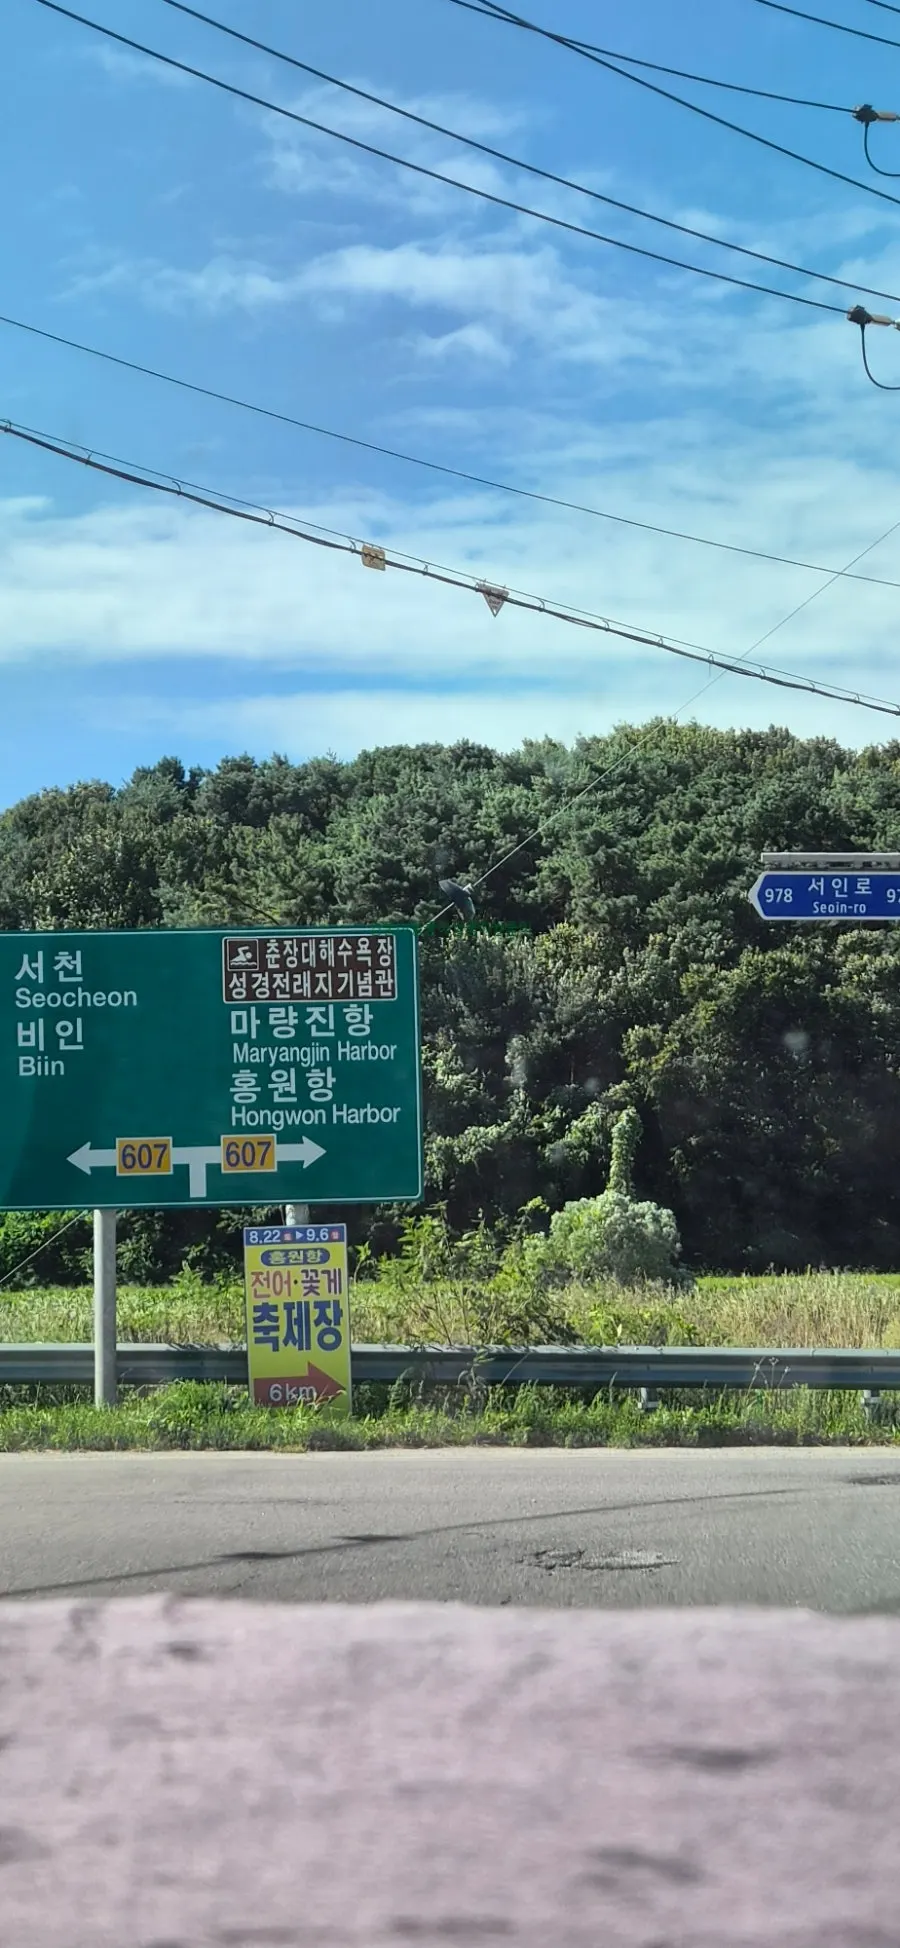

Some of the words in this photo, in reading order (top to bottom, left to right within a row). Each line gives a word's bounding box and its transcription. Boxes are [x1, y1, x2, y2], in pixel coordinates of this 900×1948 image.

[765, 888, 793, 903] 978
[808, 877, 873, 898] 서인로
[813, 901, 867, 914] Seoin-ro
[266, 937, 393, 968] 춘장대해수욕장
[14, 950, 84, 983] 서천
[15, 987, 138, 1008] Seocheon
[230, 968, 394, 1000] 성경전래지기념관
[17, 1017, 85, 1051] 비인
[230, 1004, 375, 1039] 마량진항
[19, 1056, 65, 1077] Biin
[233, 1041, 331, 1067] Maryangjin
[338, 1040, 398, 1061] Harbor
[230, 1066, 336, 1103] 홍원항
[231, 1105, 327, 1130] Hongwon
[332, 1103, 400, 1124] Harbor
[121, 1143, 168, 1170] 607
[225, 1141, 272, 1167] 607
[249, 1230, 281, 1244] 8.22
[306, 1228, 328, 1243] 9.6
[269, 1250, 322, 1264] 홍원항
[252, 1300, 343, 1353] 축제장
